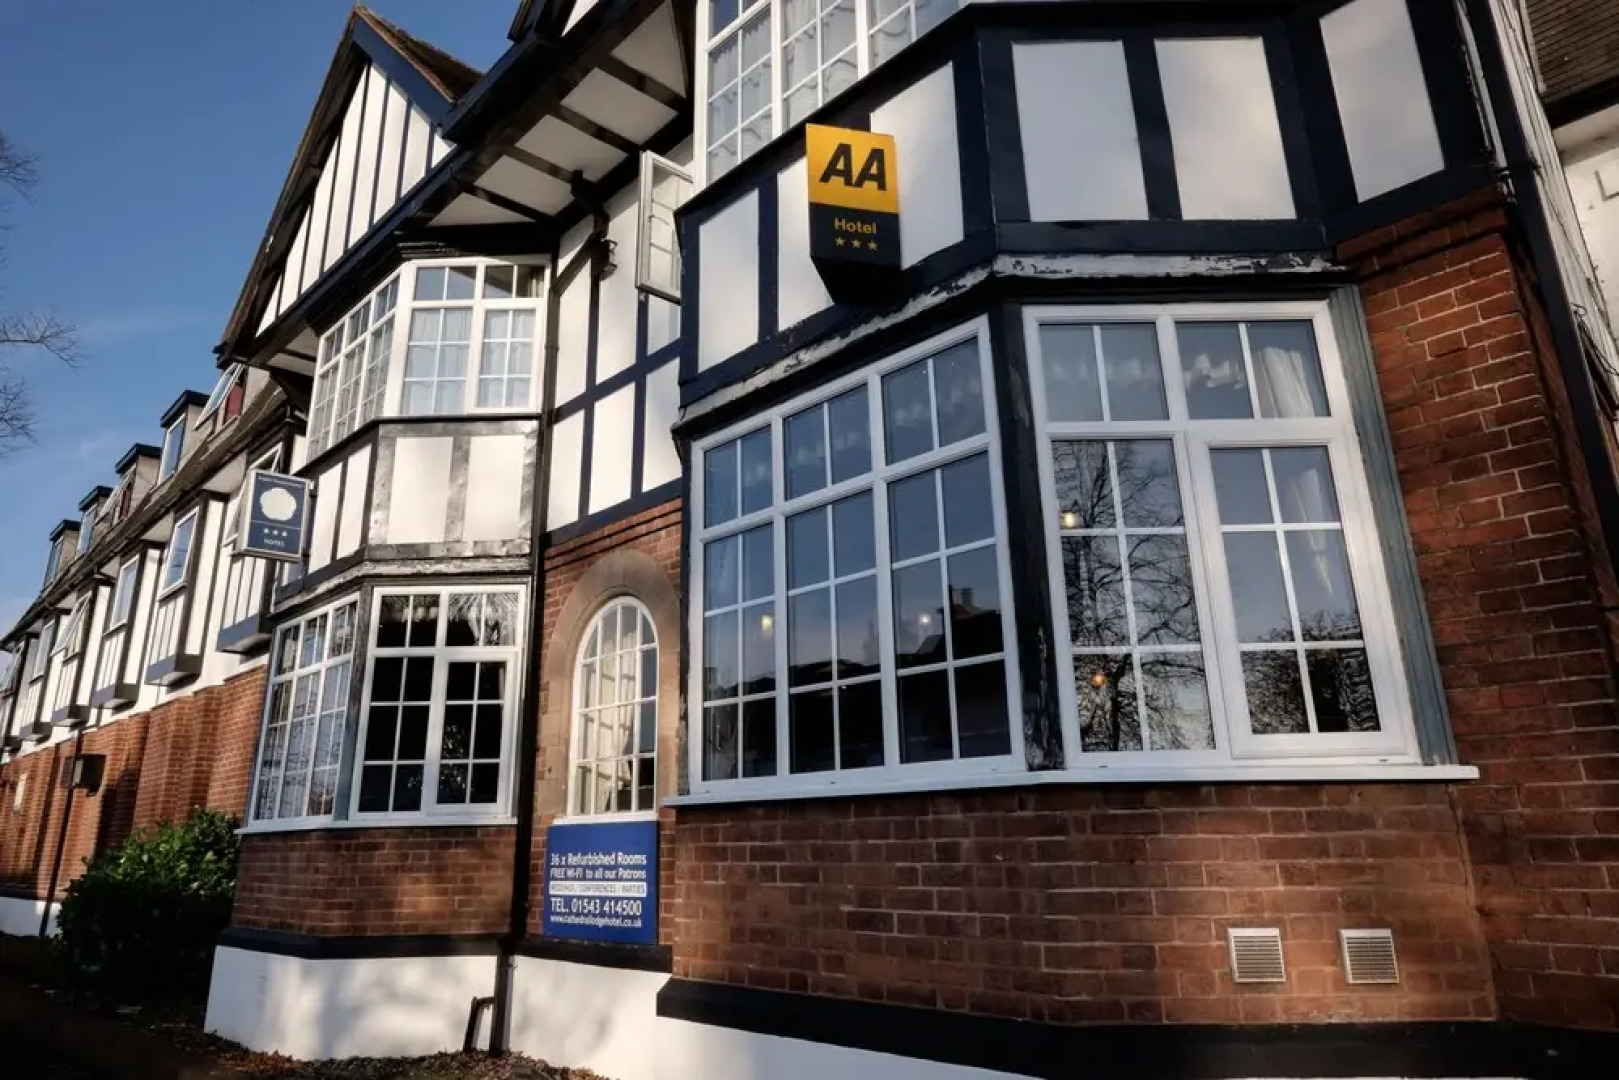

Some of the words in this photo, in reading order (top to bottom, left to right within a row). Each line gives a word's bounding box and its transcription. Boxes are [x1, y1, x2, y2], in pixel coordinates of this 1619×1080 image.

[818, 143, 887, 191] AA
[834, 217, 877, 234] Hotel
[567, 852, 616, 866] Refurbished
[617, 852, 647, 866] Rooms
[550, 867, 566, 879] FREE
[585, 868, 593, 879] to
[595, 867, 603, 879] all
[604, 870, 617, 880] our
[618, 867, 647, 880] Patrons
[550, 897, 569, 913] TEL.
[571, 898, 600, 914] 01543
[603, 899, 642, 916] 414500
